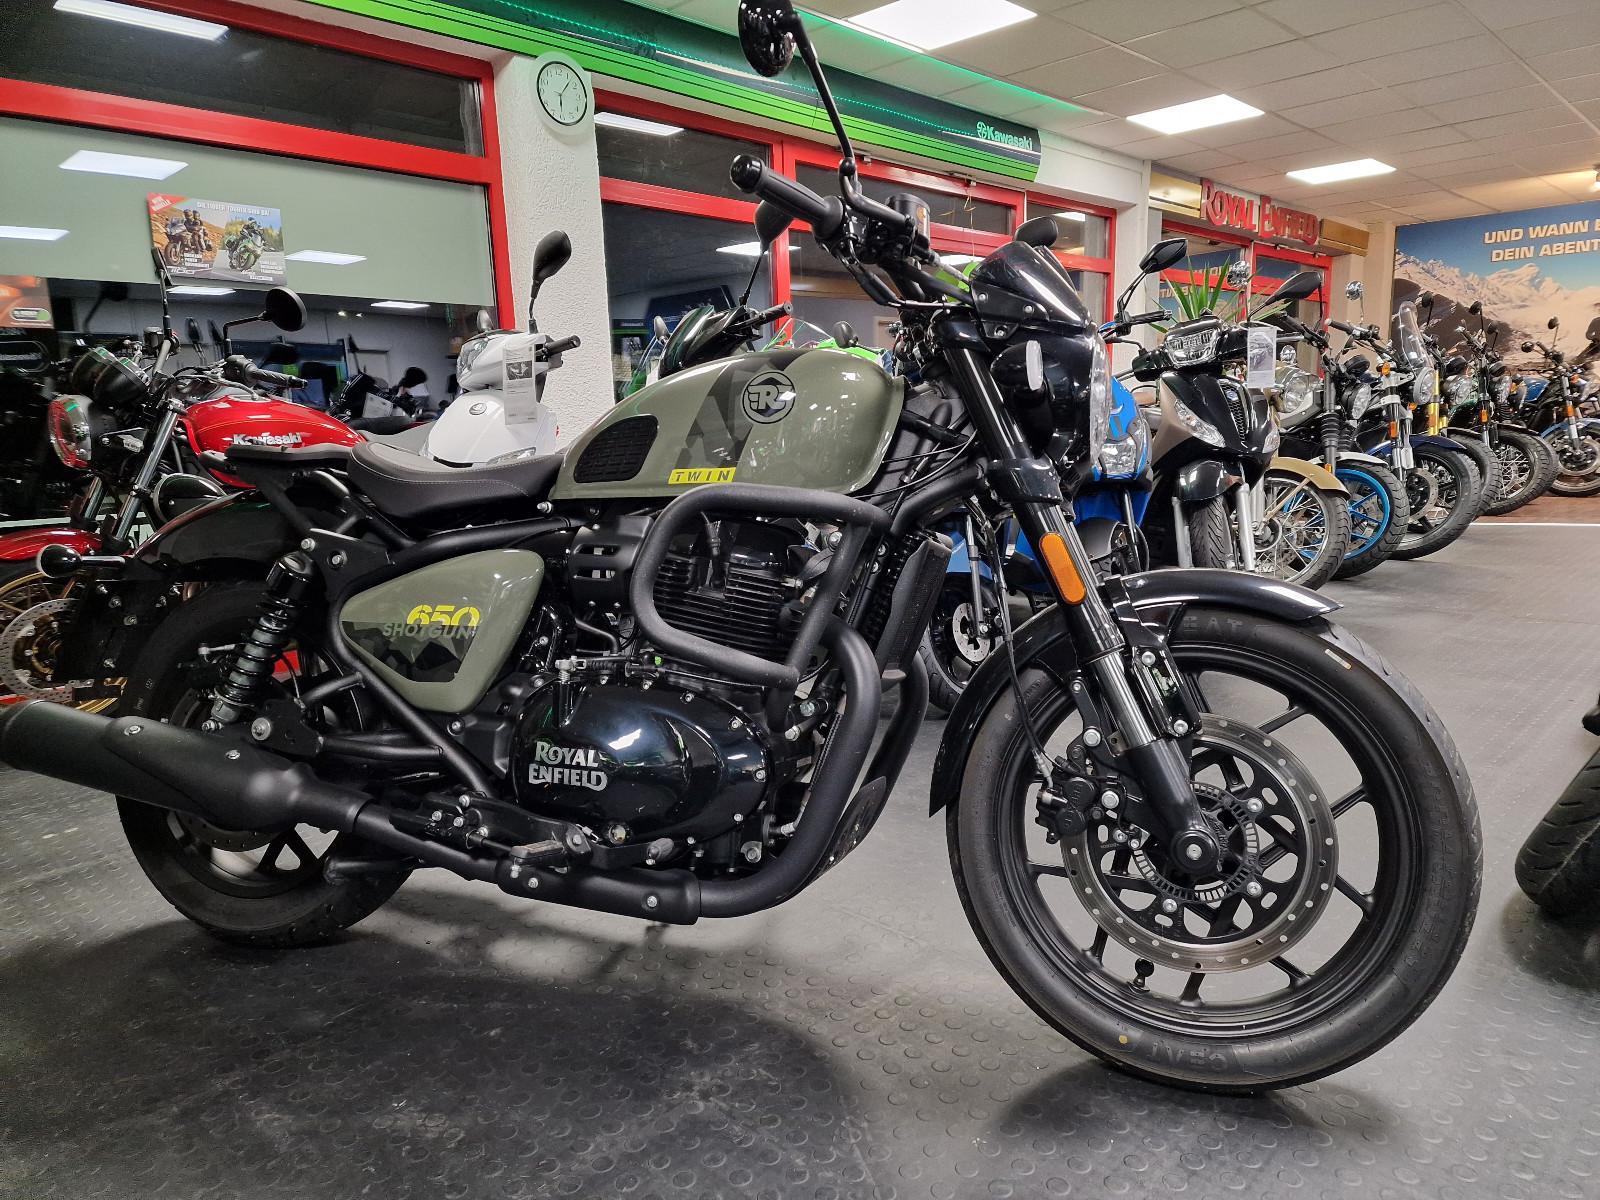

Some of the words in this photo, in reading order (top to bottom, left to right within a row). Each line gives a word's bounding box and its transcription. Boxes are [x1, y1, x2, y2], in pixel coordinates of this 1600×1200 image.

[986, 125, 1033, 151] Kawasaki
[1200, 179, 1257, 231] ROYAL
[1259, 194, 1319, 246] ENFIELD
[1484, 227, 1525, 244] UND
[1528, 219, 1590, 240] WANN
[1491, 245, 1536, 262] DEIN
[674, 470, 731, 482] TWIN
[406, 603, 481, 627] 650
[382, 622, 472, 640] SHOTGUN
[534, 740, 600, 768] ROYAL
[528, 762, 609, 793] ENFIELD
